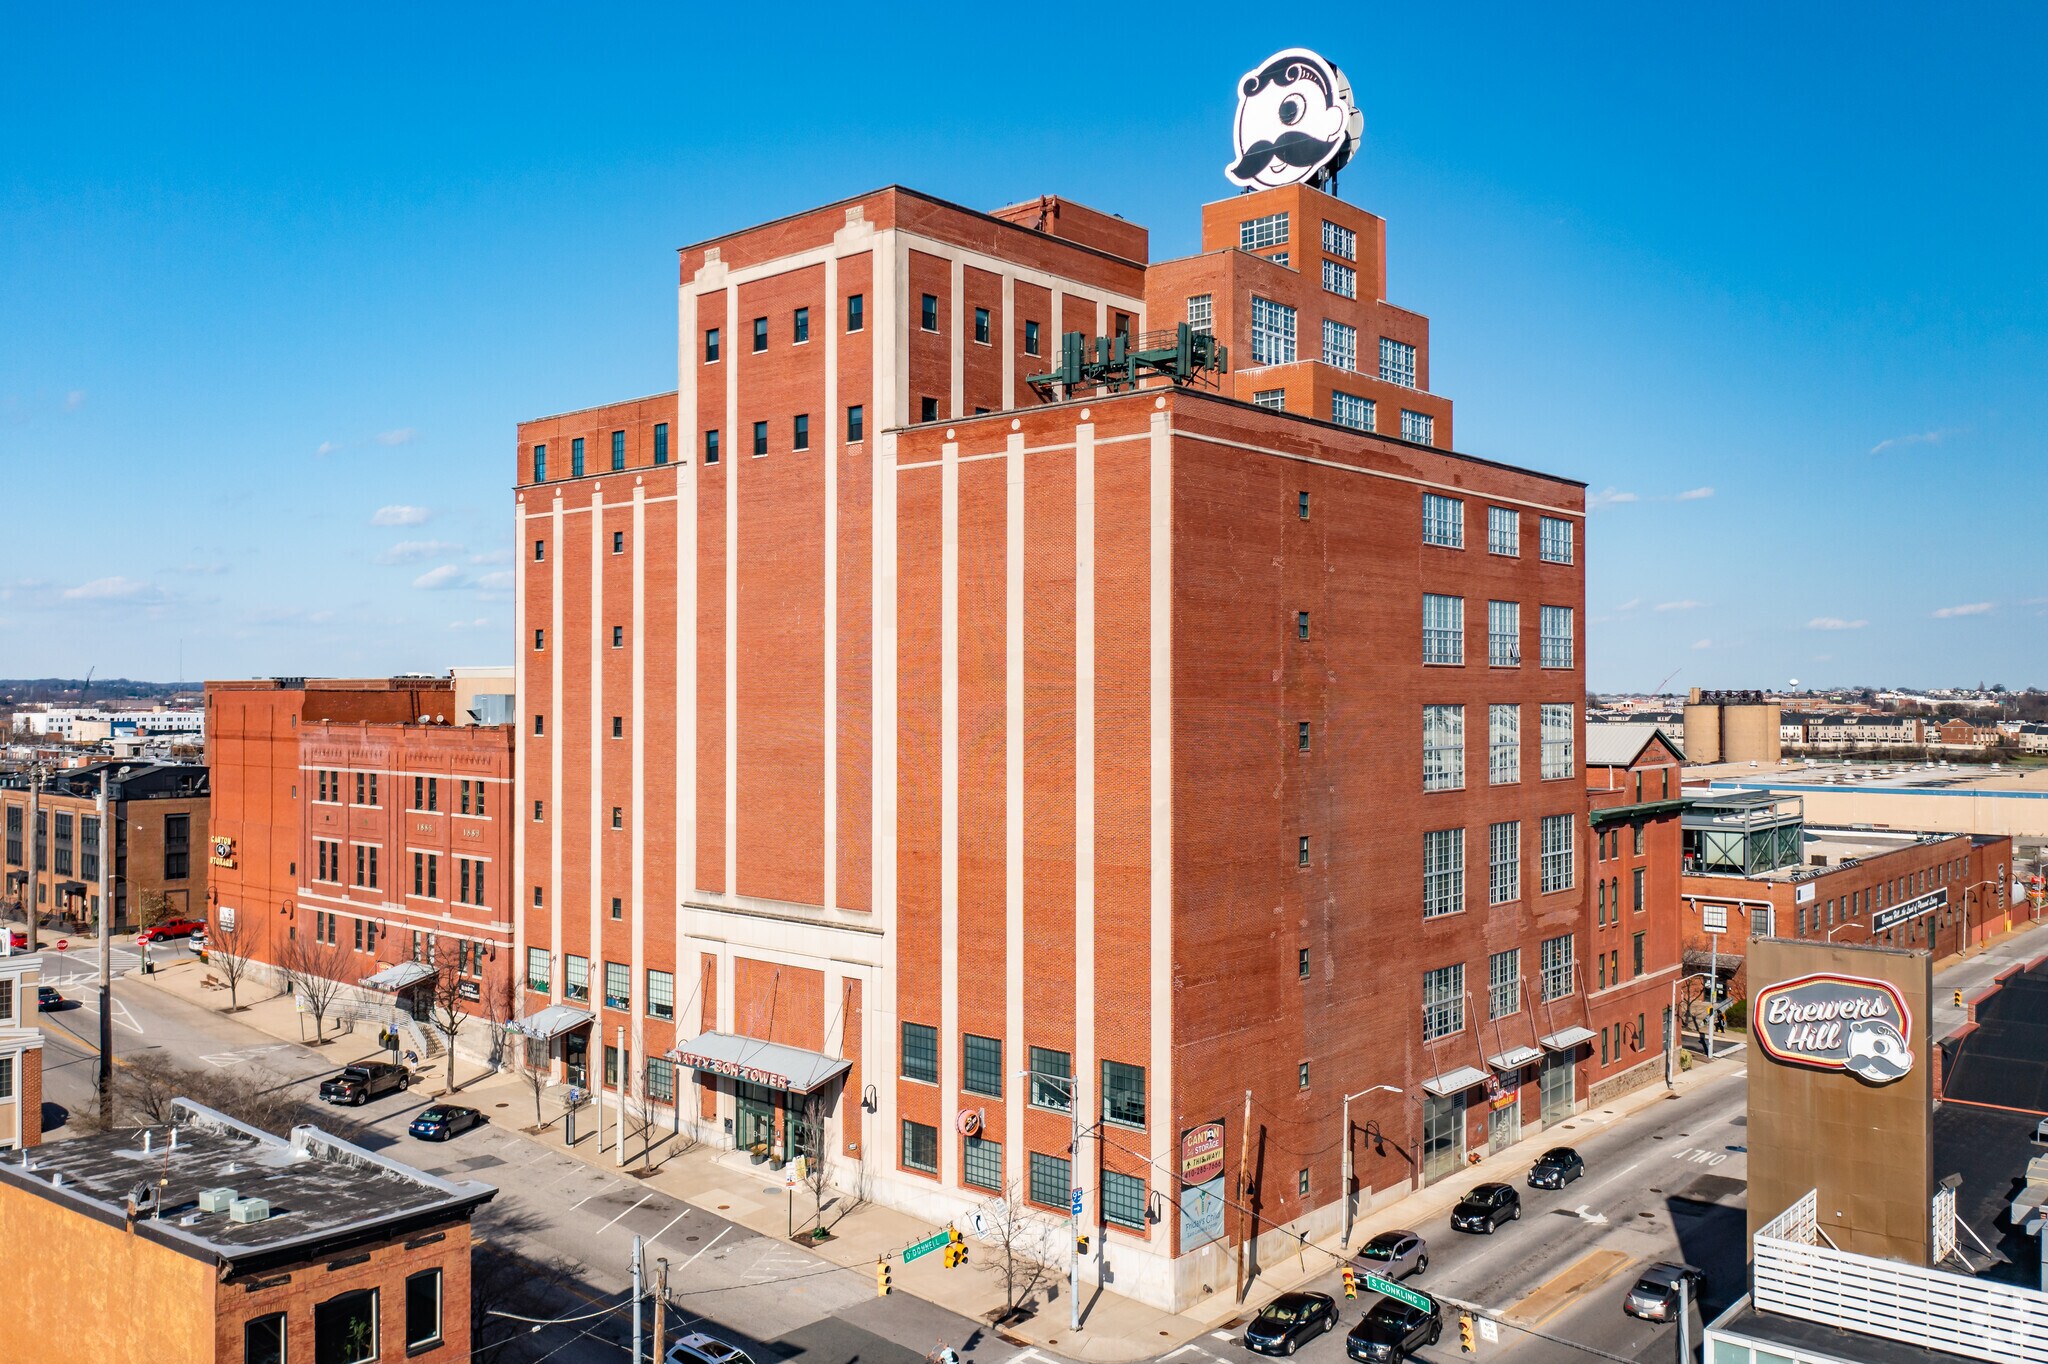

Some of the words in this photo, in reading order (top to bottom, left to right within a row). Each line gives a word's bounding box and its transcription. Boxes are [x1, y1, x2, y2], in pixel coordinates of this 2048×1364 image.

[1768, 996, 1890, 1025] Brewers
[1785, 1021, 1842, 1051] Hill
[676, 1051, 711, 1069] NATTY
[714, 1060, 740, 1077] BOH
[744, 1066, 788, 1089] TOWER
[1187, 1126, 1220, 1147] CANTN
[1195, 1139, 1220, 1154] STORAGE
[1671, 1147, 1728, 1166] ONLY
[1072, 1190, 1082, 1201] 95
[1186, 1217, 1205, 1231] Friday's
[905, 1238, 941, 1260] O'DONNELL
[1371, 1279, 1379, 1289] S.
[1380, 1282, 1418, 1304] CONKLING
